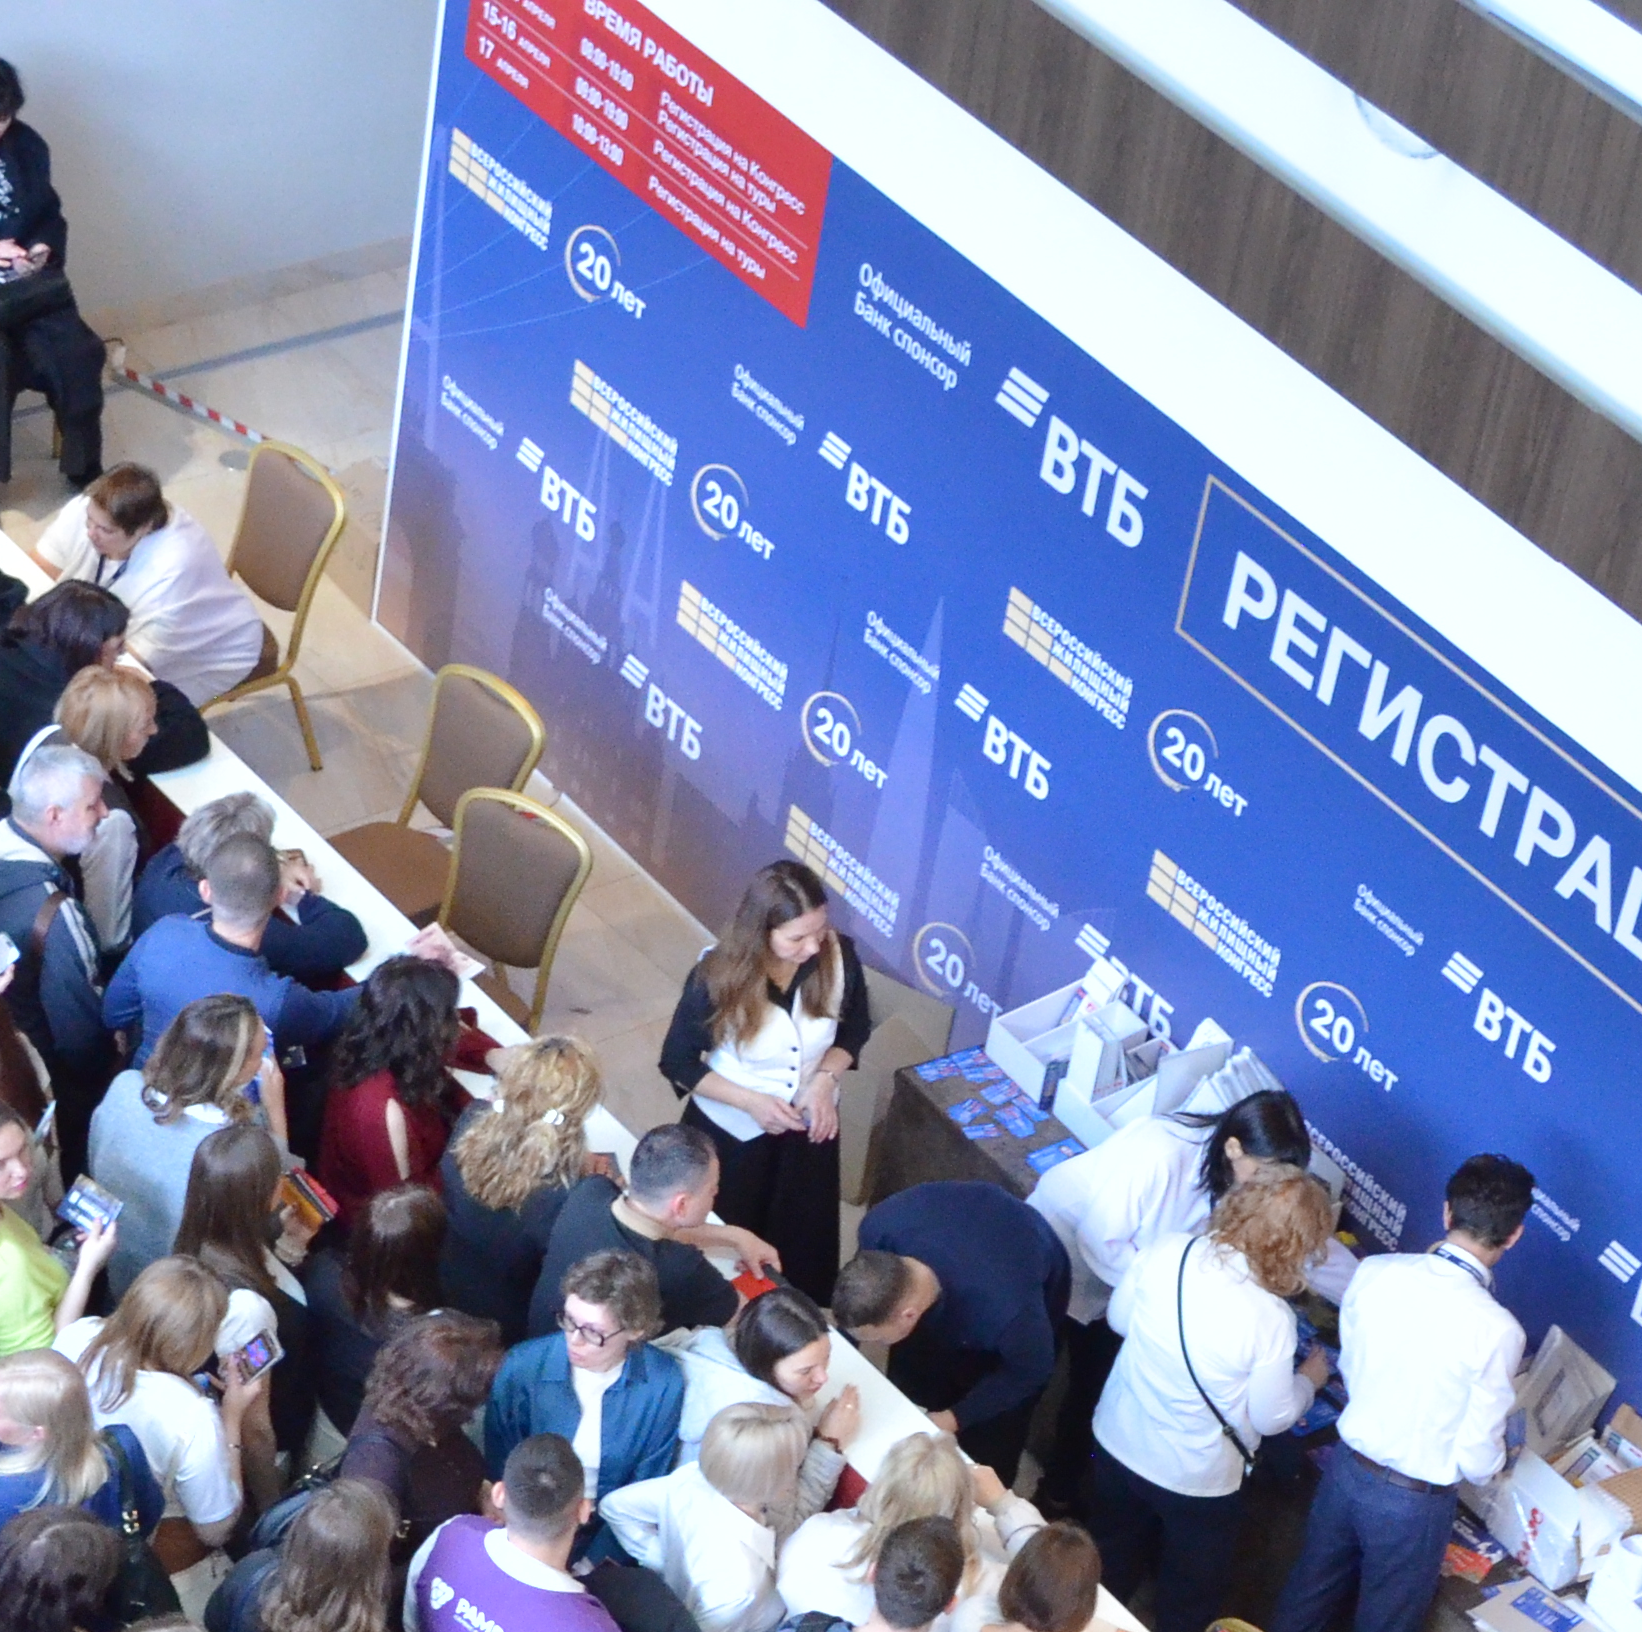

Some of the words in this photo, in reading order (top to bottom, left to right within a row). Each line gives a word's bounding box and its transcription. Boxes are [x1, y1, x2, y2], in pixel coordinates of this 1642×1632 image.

[478, 36, 495, 59] 17
[483, 1, 517, 40] 15-16
[584, 0, 642, 51] ВРЕМЯ
[643, 37, 714, 107] РАБОТЫ
[470, 142, 553, 220] ВСЕРОССИЙСКИЙ
[658, 110, 730, 177] Регистрация
[730, 169, 747, 190] на
[746, 181, 777, 213] туры
[660, 91, 733, 158] Регистрация
[734, 151, 749, 171] на
[750, 161, 806, 215] Конгресс
[487, 175, 551, 235] ЖИЛИЩНЫЙ
[503, 208, 548, 251] КОНГРЕСС
[649, 176, 719, 243] Регистрация
[719, 235, 736, 256] на
[735, 247, 766, 280] туры
[654, 140, 725, 207] Регистрация
[725, 199, 742, 221] на
[742, 210, 798, 265] Конгресс
[577, 242, 611, 290] 20
[611, 281, 646, 318] лет
[859, 262, 972, 367] Официальный
[854, 292, 891, 338] Банк
[892, 328, 958, 391] спонсор
[593, 375, 678, 454] ВСЕРОССИЙСКИЙ
[611, 409, 676, 471] ЖИЛИЩНЫЙ
[541, 466, 596, 541] ВТБ
[627, 441, 673, 486] КОНГРЕСС
[846, 462, 912, 545] ВТБ
[1040, 414, 1149, 548] ВТБ
[703, 480, 739, 529] 20
[739, 520, 775, 560] лет
[701, 597, 788, 682] ВСЕРОССИЙСКИЙ
[718, 632, 785, 696] ЖИЛИЩНЫЙ
[1032, 605, 1133, 699] ВСЕРОССИЙСКИЙ
[1052, 641, 1130, 714] ЖИЛИЩНЫЙ
[644, 683, 703, 760] ВТБ
[735, 662, 784, 712] КОНГРЕСС
[1070, 677, 1126, 731] КОНГРЕСС
[814, 708, 851, 756] 20
[850, 749, 888, 789] лет
[983, 715, 1052, 800] ВТБ
[1161, 726, 1205, 781] 20
[1203, 772, 1248, 817] лет
[808, 822, 900, 913] ВСЕРОССИЙСКИЙ
[827, 858, 897, 926] ЖИЛИЩНЫЙ
[843, 888, 894, 939] КОНГРЕСС
[1176, 868, 1281, 965] ВСЕРОССИЙСКИЙ
[1196, 905, 1278, 982] ЖИЛИЩНЫЙ
[925, 938, 965, 988] 20
[962, 978, 1003, 1020] лет
[1215, 941, 1273, 998] КОНГРЕСС
[1309, 999, 1355, 1053] 20
[1353, 1046, 1399, 1092] лет
[1473, 987, 1557, 1084] ВТБ
